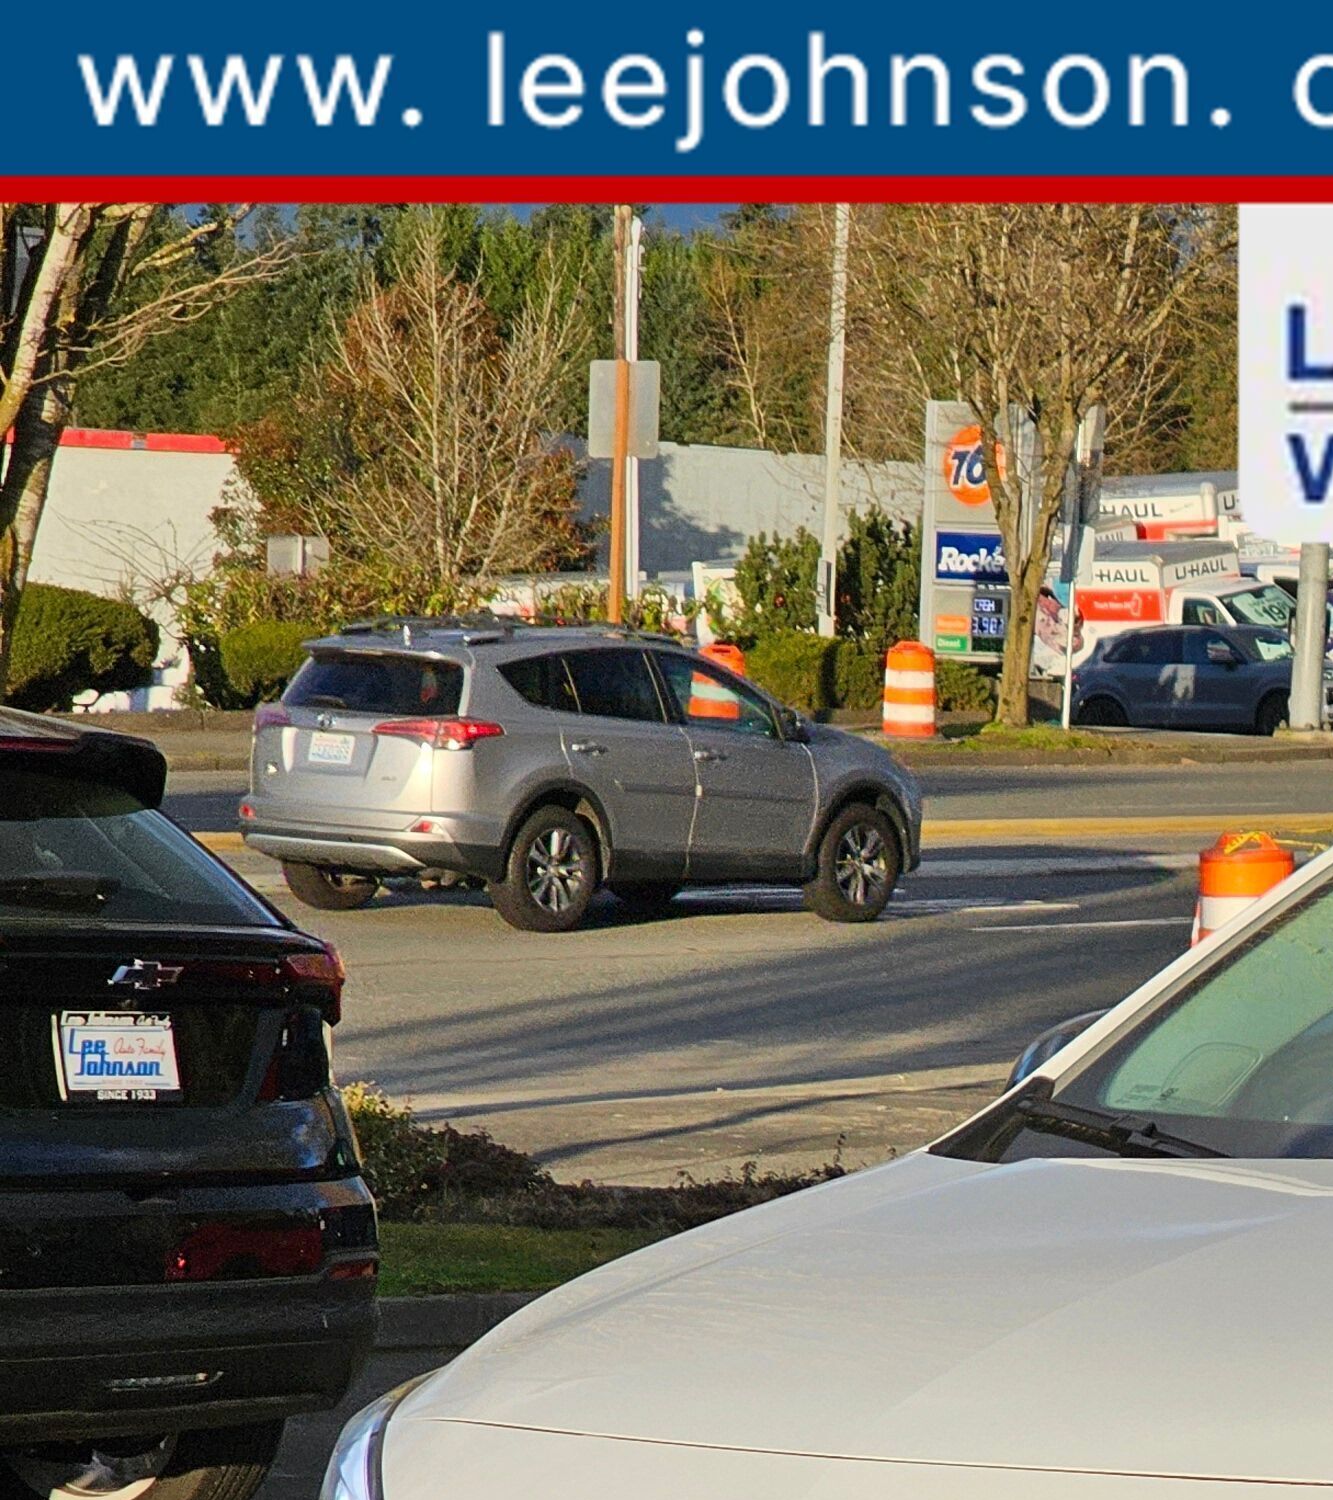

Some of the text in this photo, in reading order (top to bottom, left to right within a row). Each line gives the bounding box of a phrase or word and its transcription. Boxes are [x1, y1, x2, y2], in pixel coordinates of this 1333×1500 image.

[950, 450, 988, 486] 76
[1174, 557, 1229, 581] U-HAUL
[69, 1028, 109, 1054] Lee
[74, 1053, 165, 1076] Johnson
[97, 1089, 156, 1100] SINCE 1933
